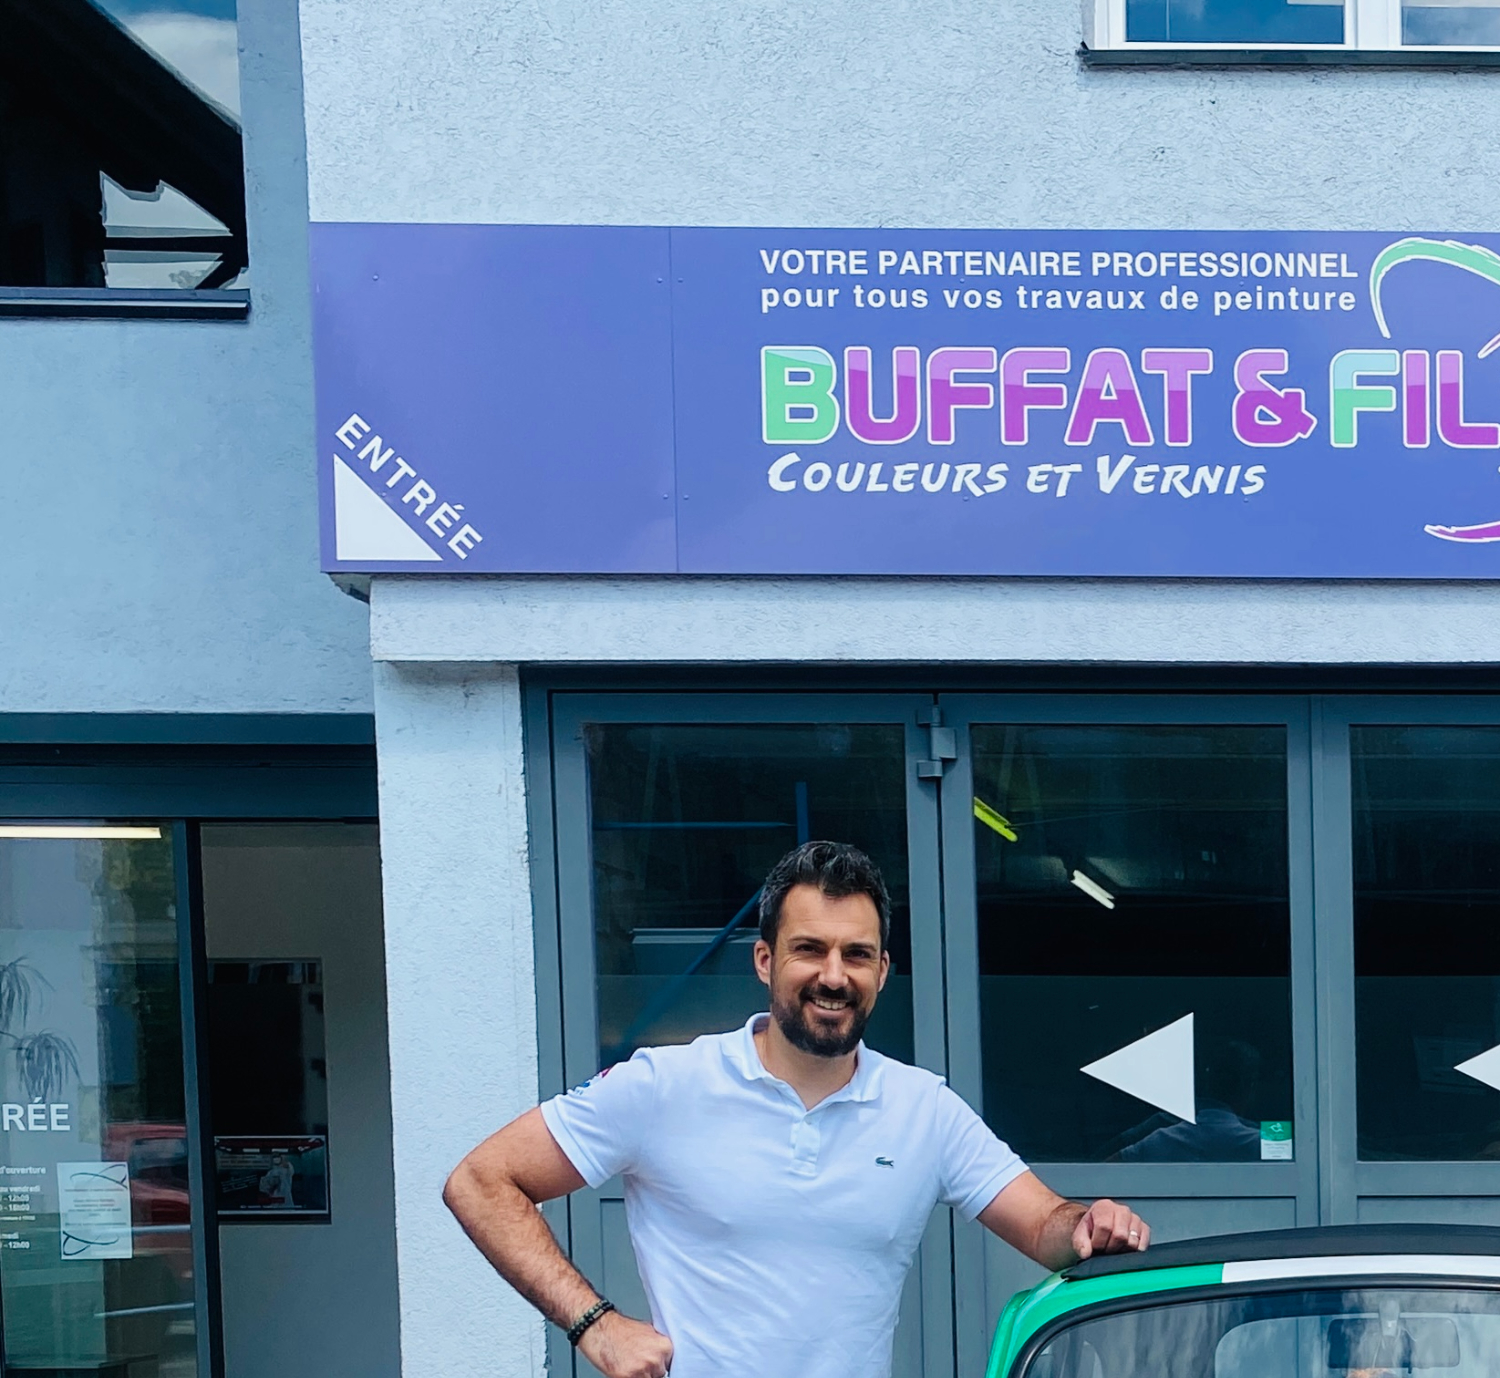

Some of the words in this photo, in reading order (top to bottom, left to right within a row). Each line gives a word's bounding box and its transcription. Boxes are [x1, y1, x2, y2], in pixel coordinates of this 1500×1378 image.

[760, 249, 868, 276] VOTRE
[879, 250, 1081, 277] PARTENAIRE
[1092, 251, 1358, 278] PROFESSIONNEL
[761, 287, 840, 314] pour
[853, 284, 928, 309] tous
[943, 289, 1002, 310] vos
[1016, 285, 1145, 310] travaux
[1160, 285, 1199, 311] de
[1214, 285, 1356, 316] peinture
[761, 346, 1213, 447] BUFFAT
[1232, 348, 1318, 447] &
[334, 412, 484, 561] ENTRÉE
[1026, 463, 1083, 498] ET
